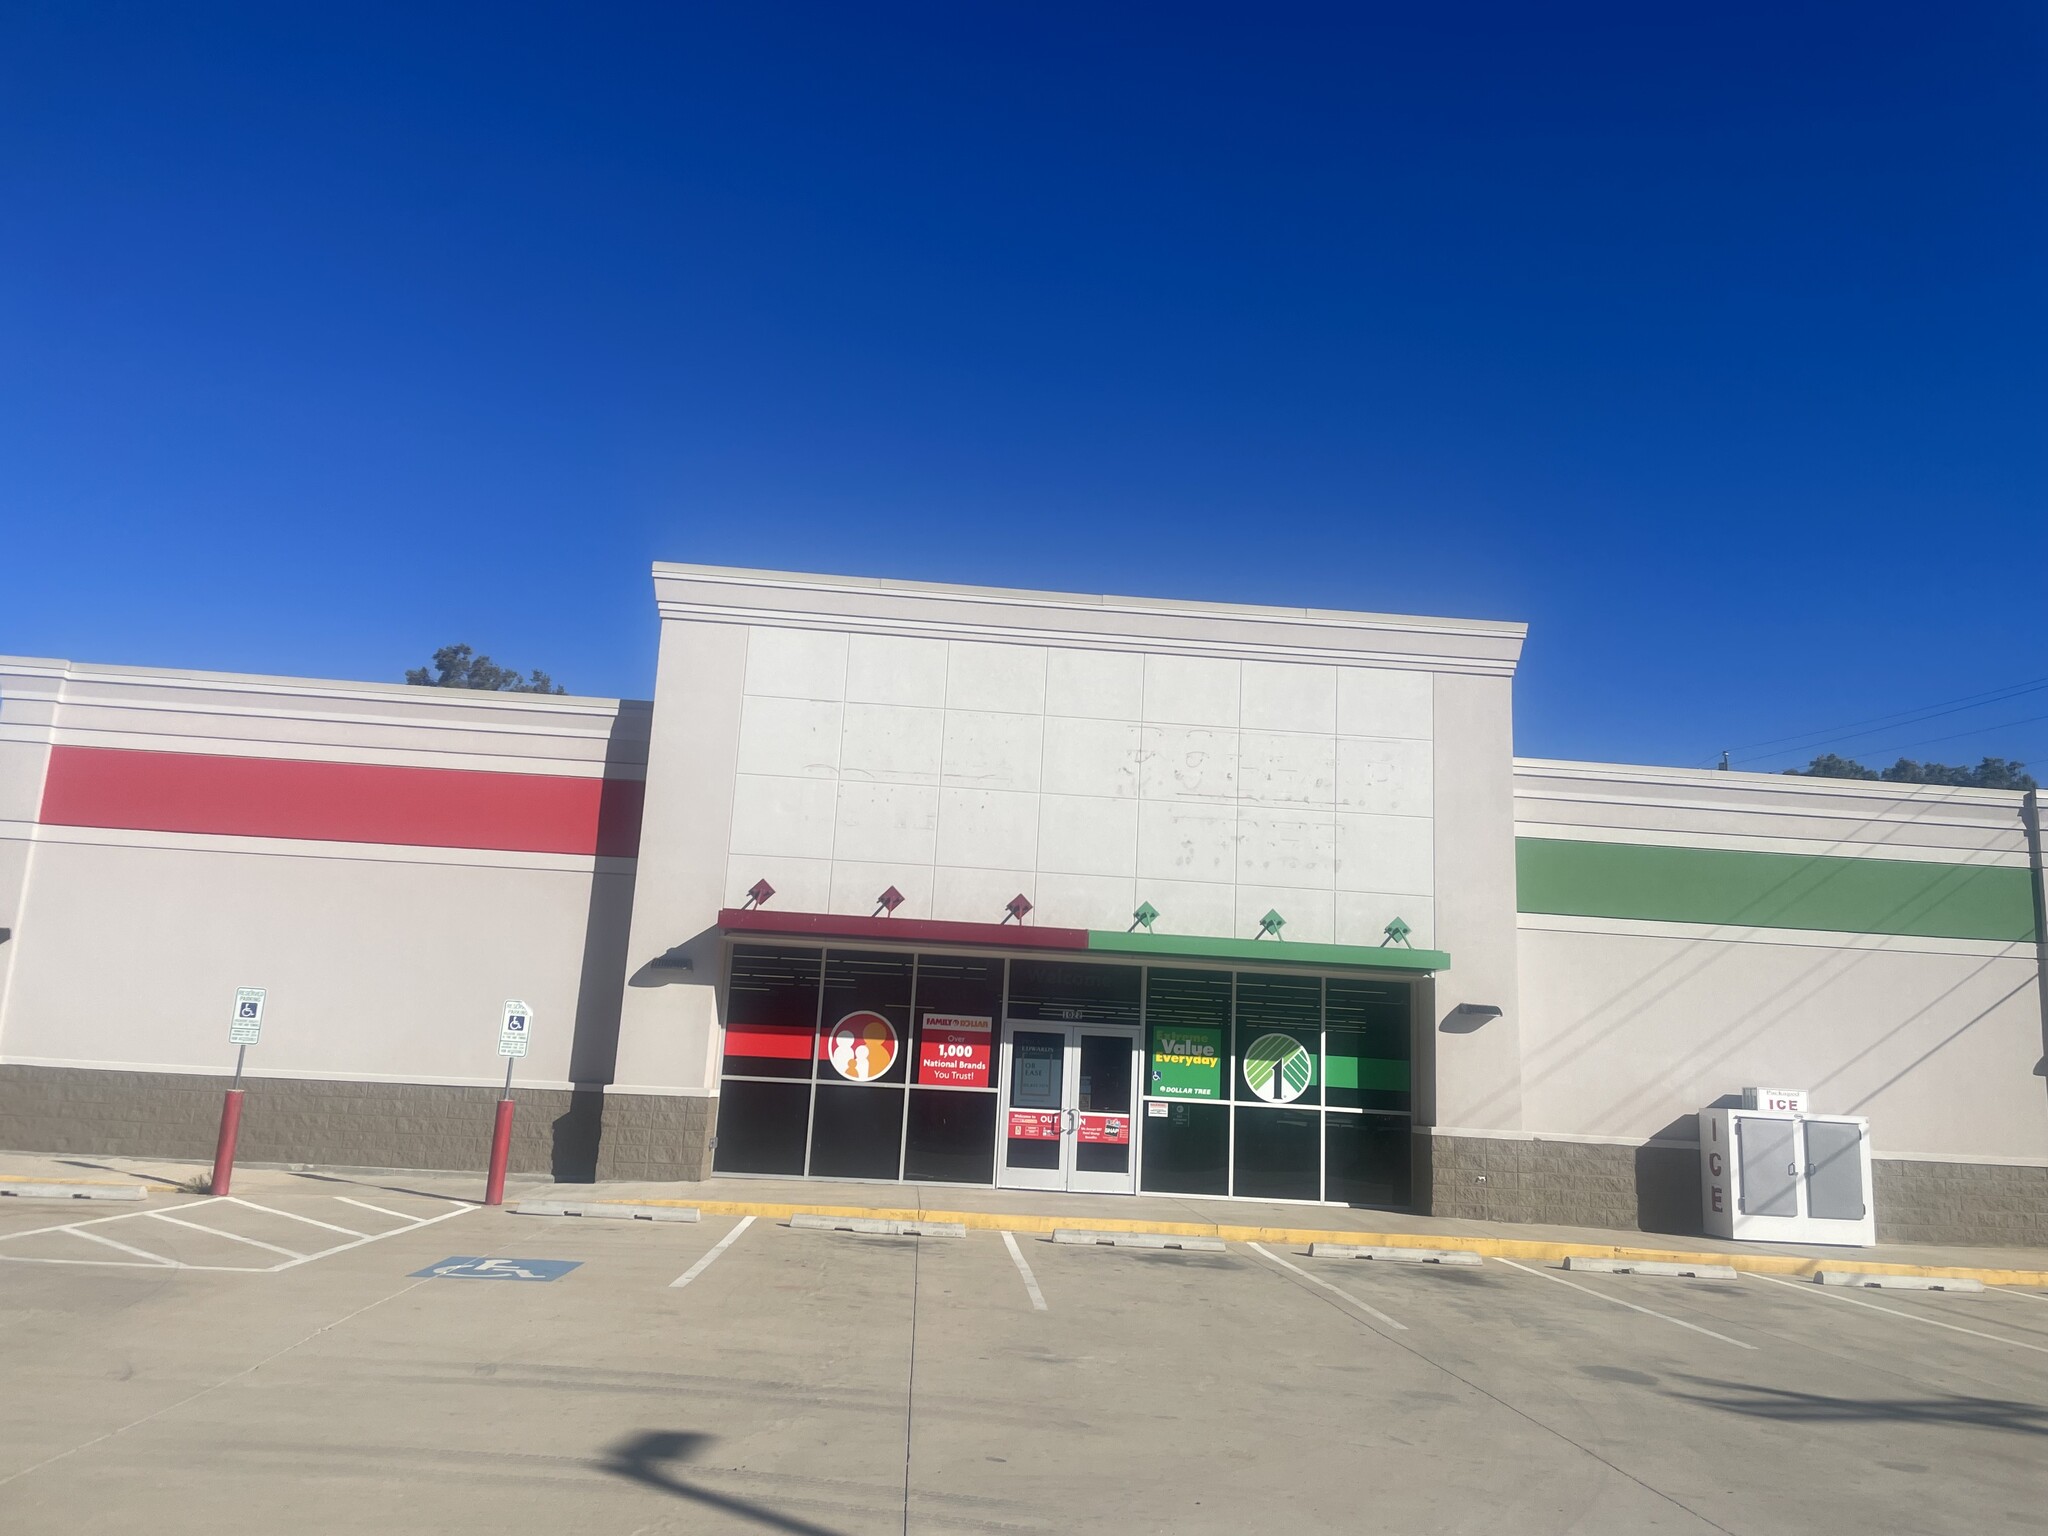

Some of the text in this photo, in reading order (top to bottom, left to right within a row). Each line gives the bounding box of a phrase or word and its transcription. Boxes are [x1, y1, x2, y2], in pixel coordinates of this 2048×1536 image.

[926, 1018, 952, 1026] FAMILY
[1156, 1030, 1208, 1042] Extreme
[939, 1044, 972, 1058] 1,000
[1161, 1039, 1215, 1056] Value
[923, 1059, 986, 1070] National Brands
[1155, 1052, 1219, 1068] Everyday
[934, 1070, 974, 1080] You Trust!
[1769, 1099, 1798, 1111] ICE
[1040, 1115, 1058, 1124] OUT
[1709, 1117, 1723, 1213] ICE
